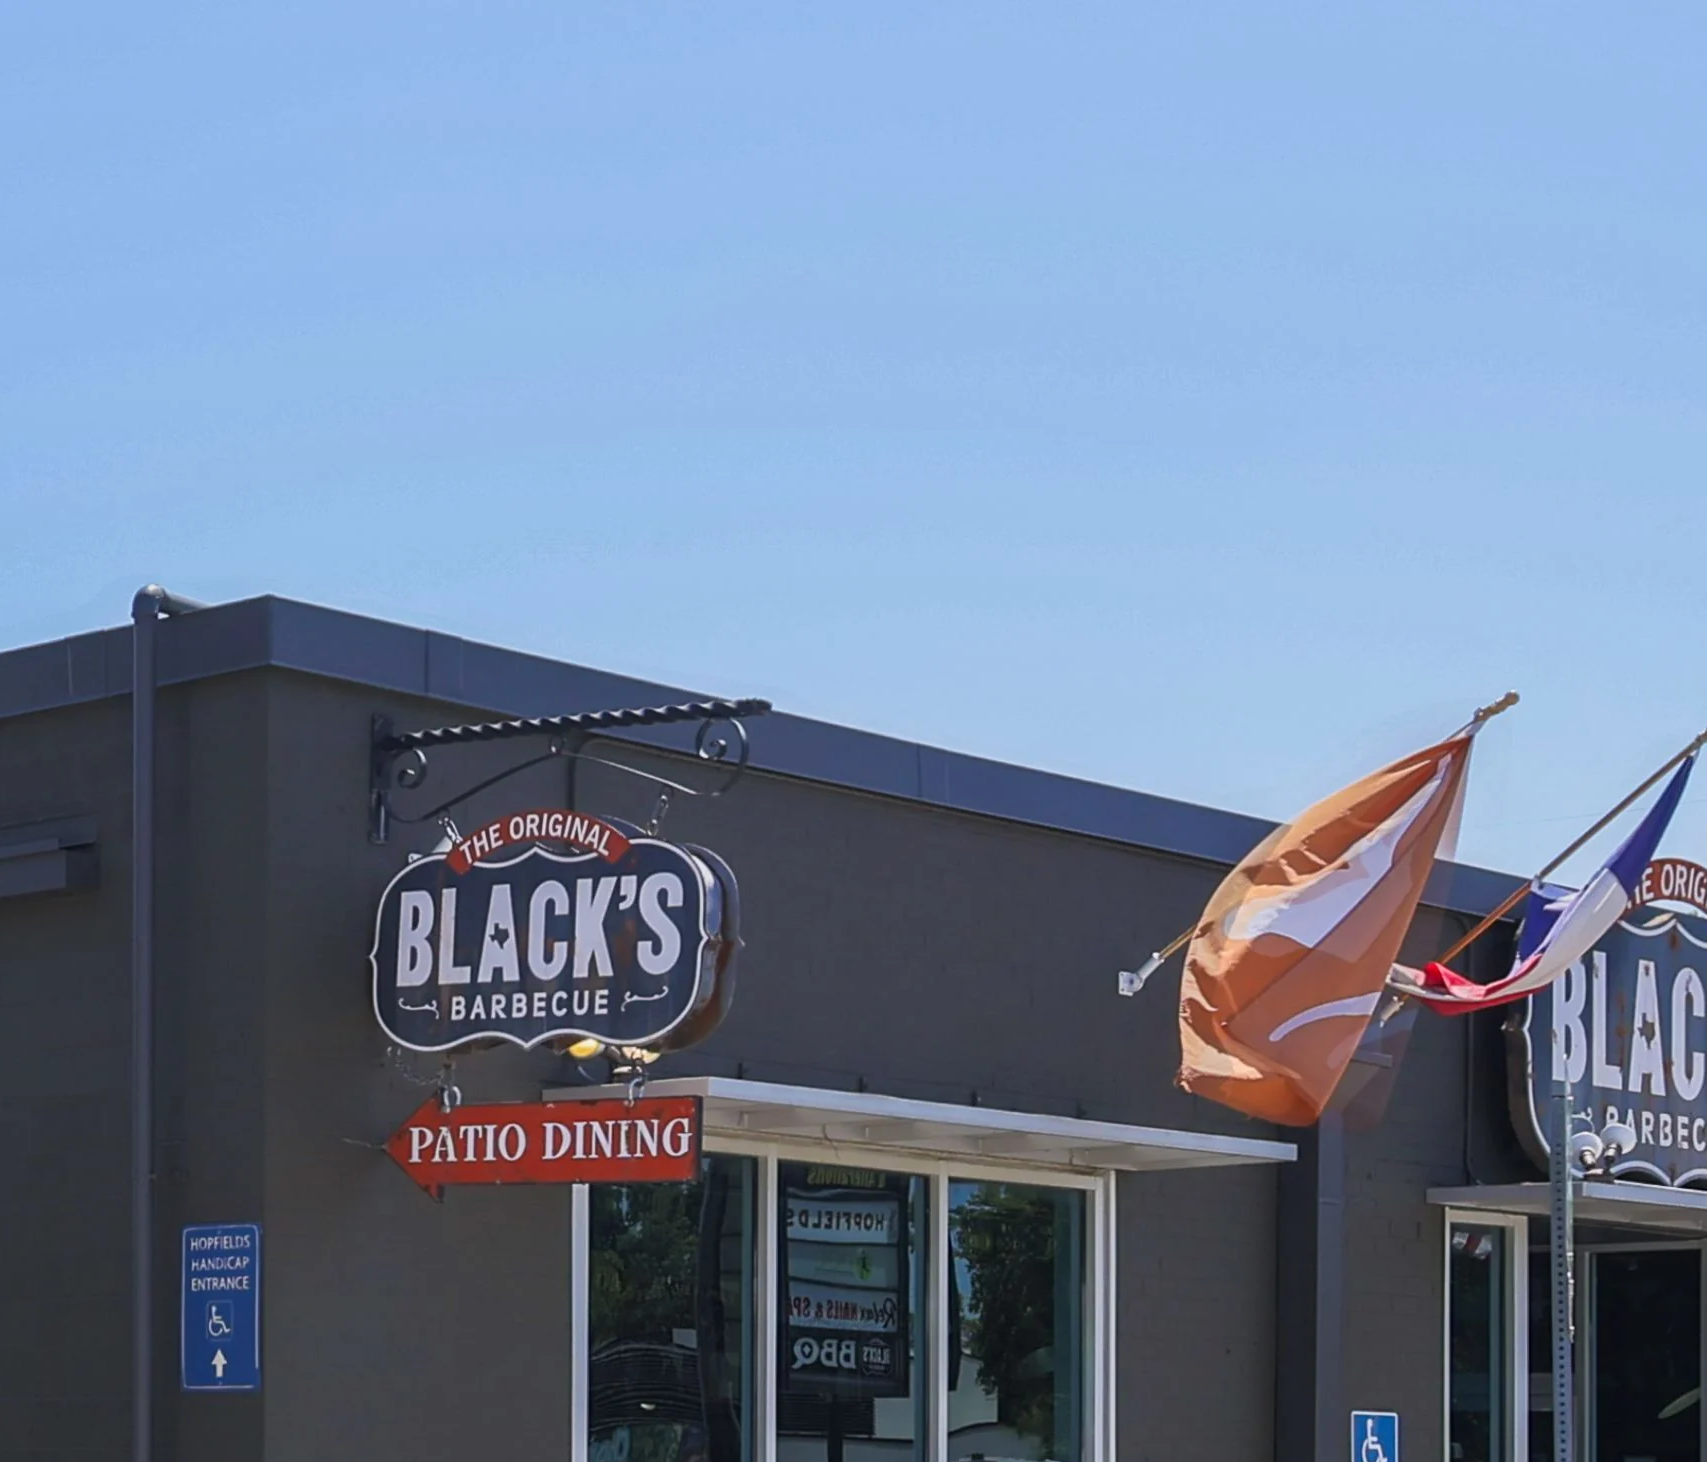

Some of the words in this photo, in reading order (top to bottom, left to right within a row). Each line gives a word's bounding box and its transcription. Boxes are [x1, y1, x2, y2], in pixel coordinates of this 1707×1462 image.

[459, 823, 504, 865] THE
[509, 812, 611, 857] ORIGINAL
[395, 872, 685, 988] BLACK'S
[450, 989, 609, 1021] BARBECUE
[408, 1122, 527, 1164] PATIO
[541, 1116, 693, 1161] DINING
[189, 1234, 251, 1252] HOPFIELDS
[190, 1255, 250, 1272] HANDICAP
[190, 1275, 250, 1292] ENTRANCE
